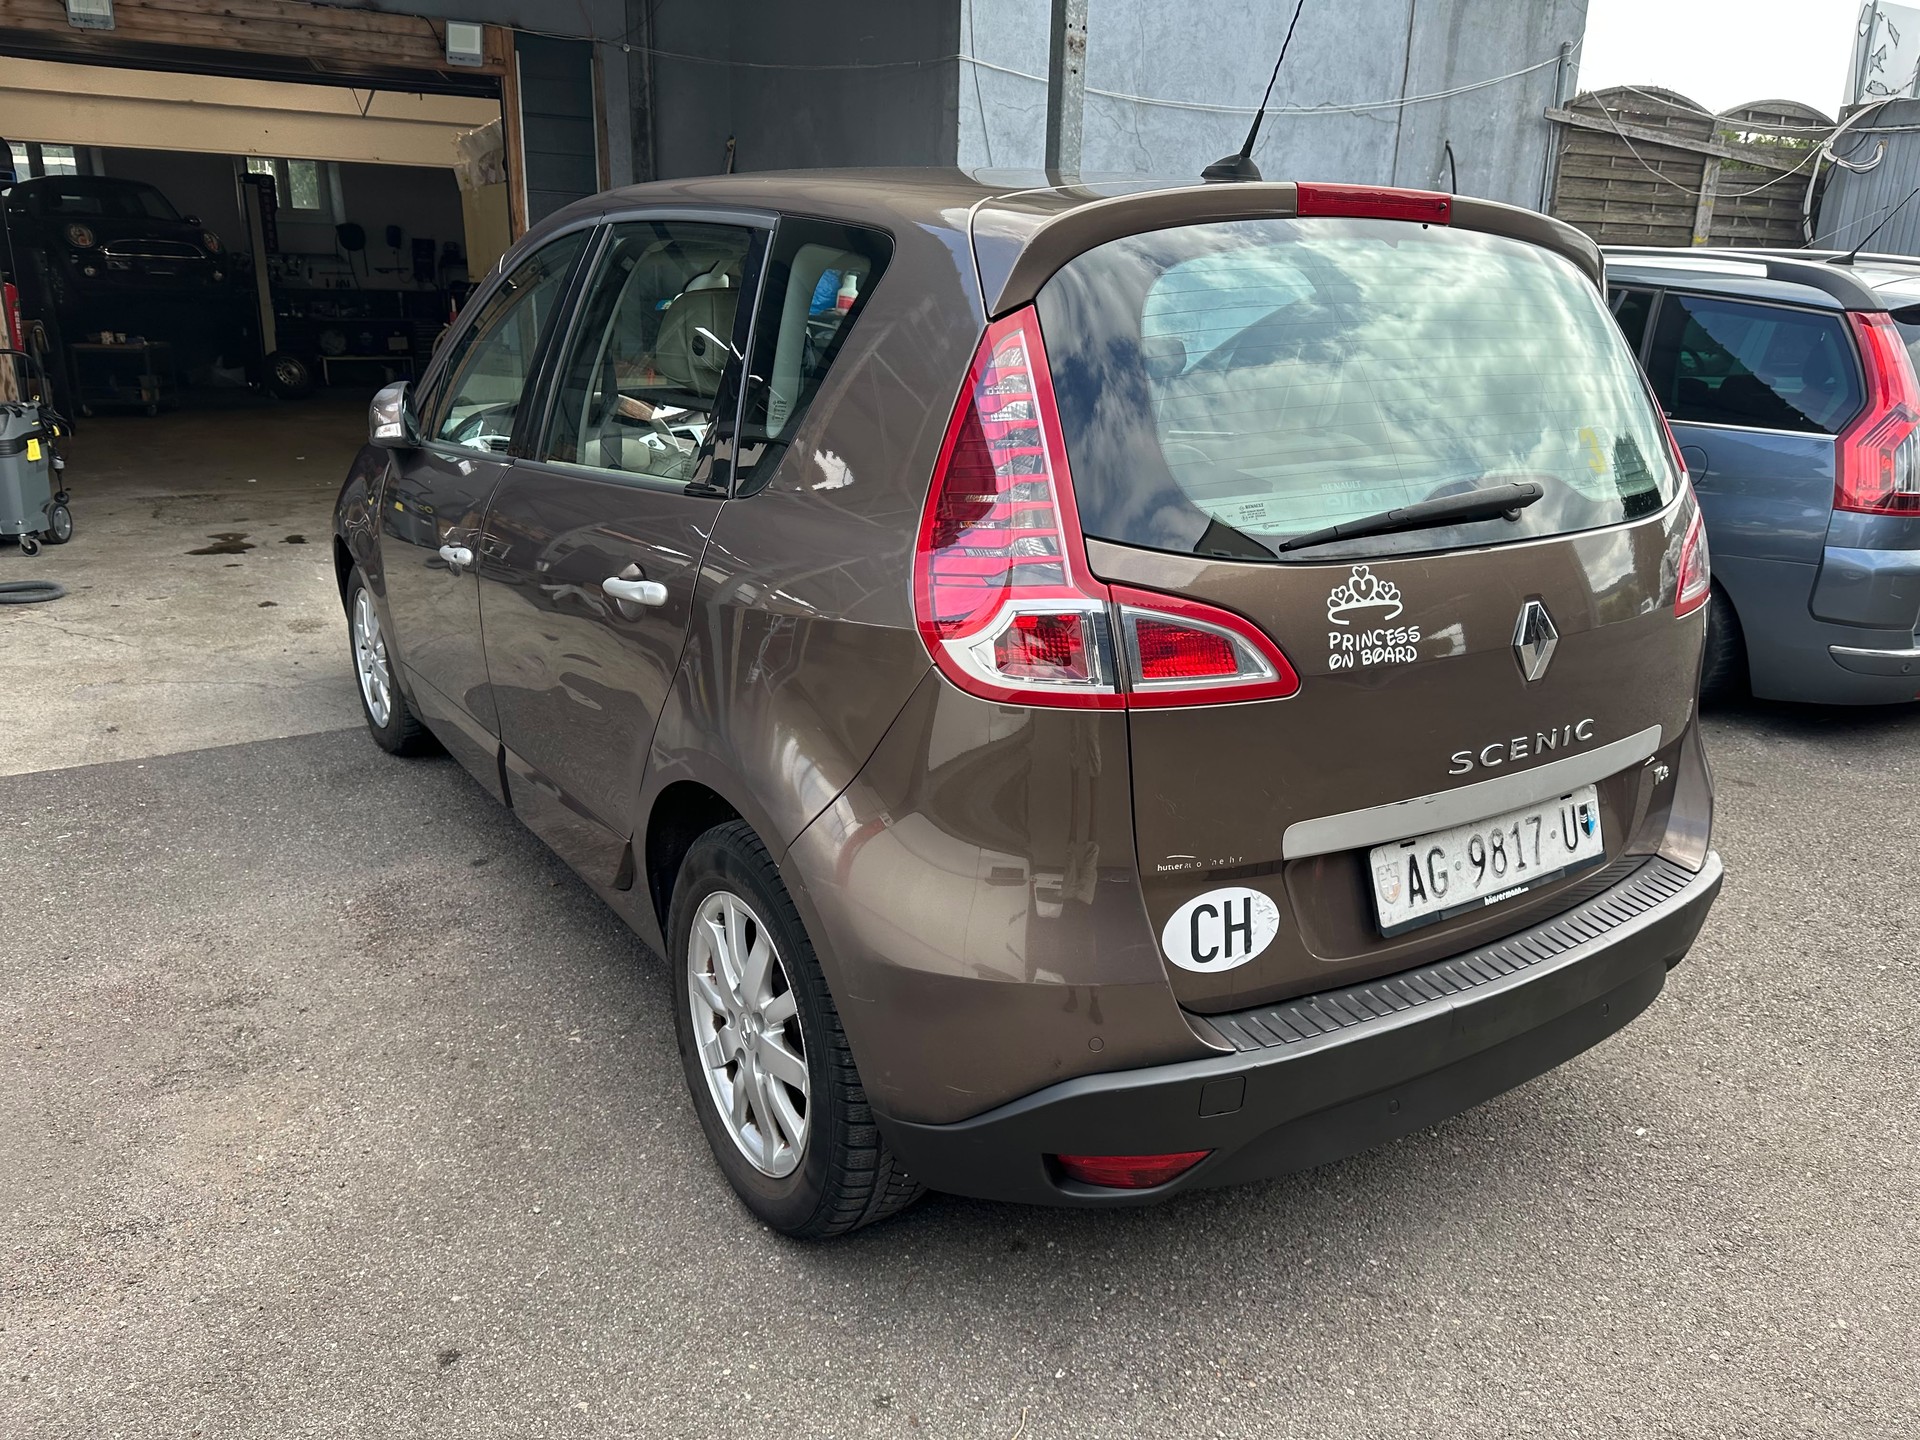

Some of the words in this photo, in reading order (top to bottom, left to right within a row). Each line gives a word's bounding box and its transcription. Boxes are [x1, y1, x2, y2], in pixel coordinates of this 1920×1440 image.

[1321, 480, 1361, 492] RENAULT
[1328, 625, 1421, 651] PRINCESS
[1328, 651, 1354, 671] ON
[1360, 645, 1417, 666] BOARD
[1448, 718, 1595, 775] SCENIC
[1408, 846, 1450, 908] AG
[1467, 813, 1542, 890] 9817
[1559, 803, 1579, 853] U
[1190, 896, 1252, 963] CH
